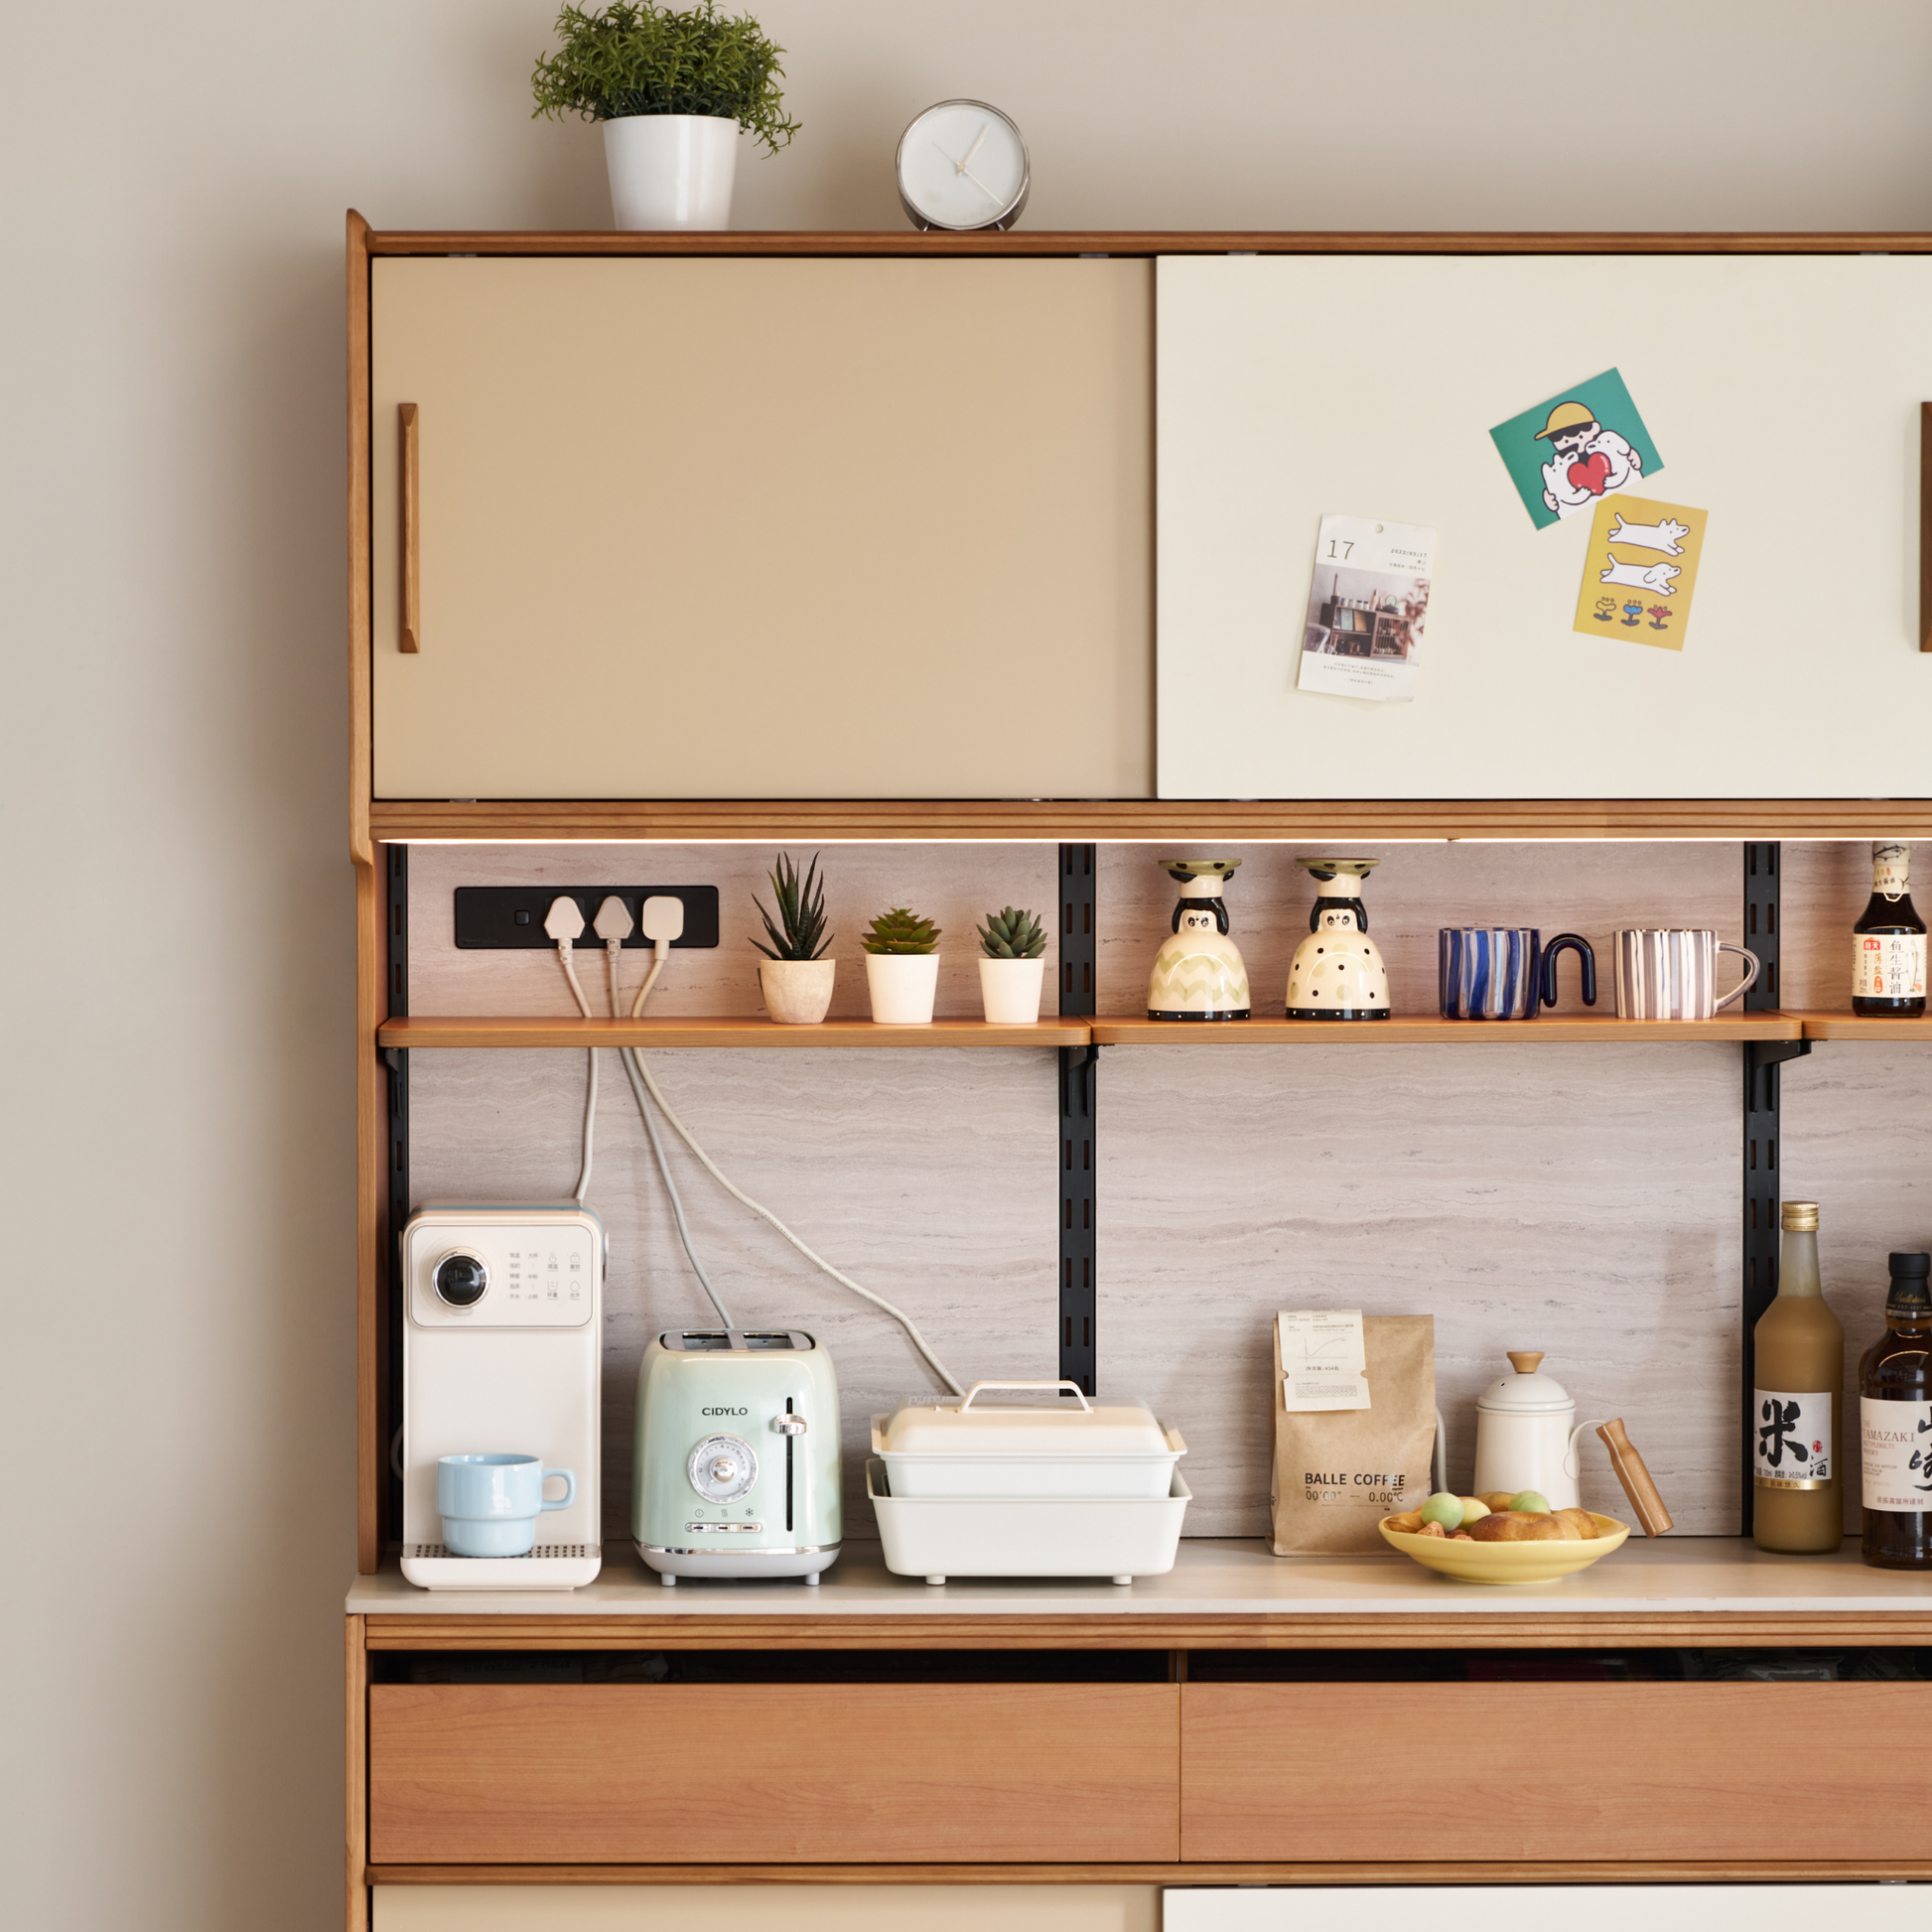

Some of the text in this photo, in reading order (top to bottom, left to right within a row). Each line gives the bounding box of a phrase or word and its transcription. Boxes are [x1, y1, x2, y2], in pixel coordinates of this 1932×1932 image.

[1327, 539, 1355, 561] 17
[1390, 548, 1428, 558] 2022/05/17
[1887, 939, 1904, 994] 鱼生酱油
[702, 1407, 749, 1417] CIDYLO
[1759, 1399, 1809, 1469] 米
[1809, 1455, 1829, 1477] 酒
[1305, 1472, 1406, 1486] BALLE COFFEE
